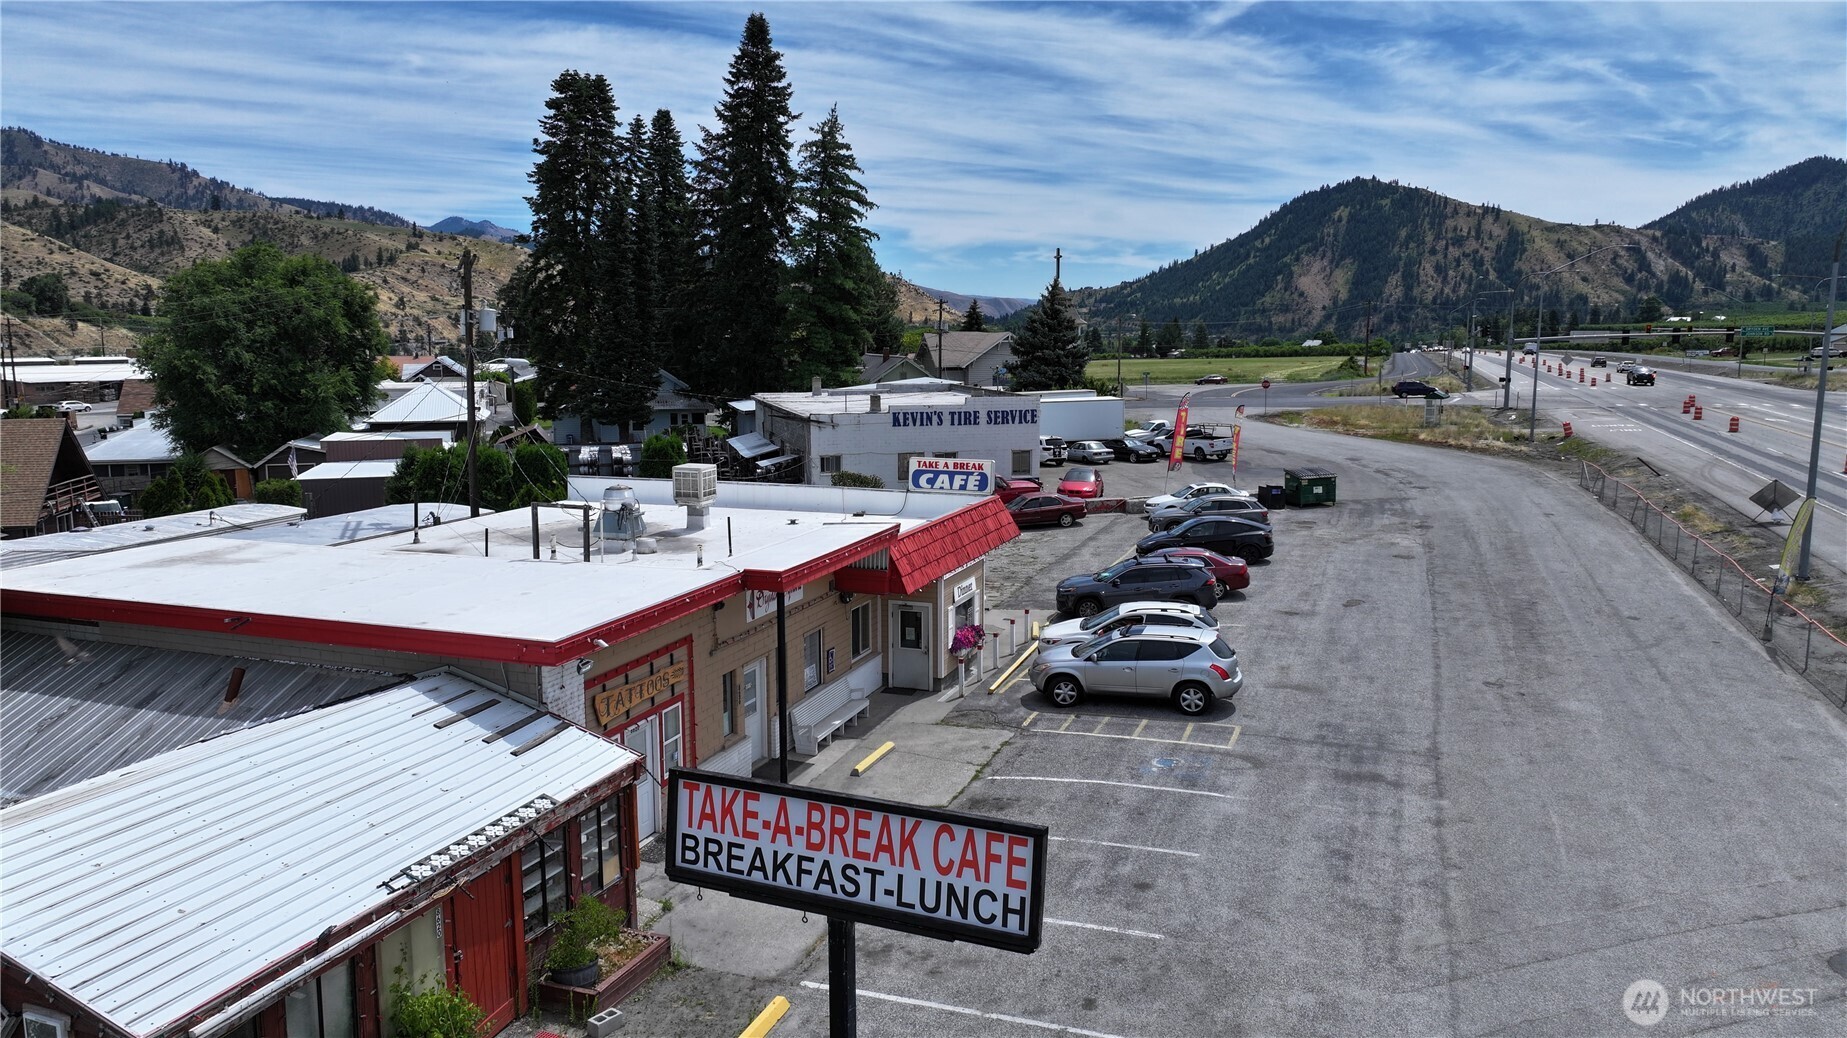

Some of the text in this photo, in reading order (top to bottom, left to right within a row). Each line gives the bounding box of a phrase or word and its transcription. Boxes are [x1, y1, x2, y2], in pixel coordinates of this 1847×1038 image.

[892, 409, 1038, 427] KEVIN'S TIRE SERVICE
[1174, 411, 1187, 459] TIRE
[916, 460, 984, 471] TAKE A BREAK
[918, 472, 982, 491] CAFÉ
[600, 671, 670, 718] TATTOOS
[683, 780, 1028, 890] TAKE-A-BREAK CAFE
[680, 832, 1027, 931] BREAKFAST-LUNCH
